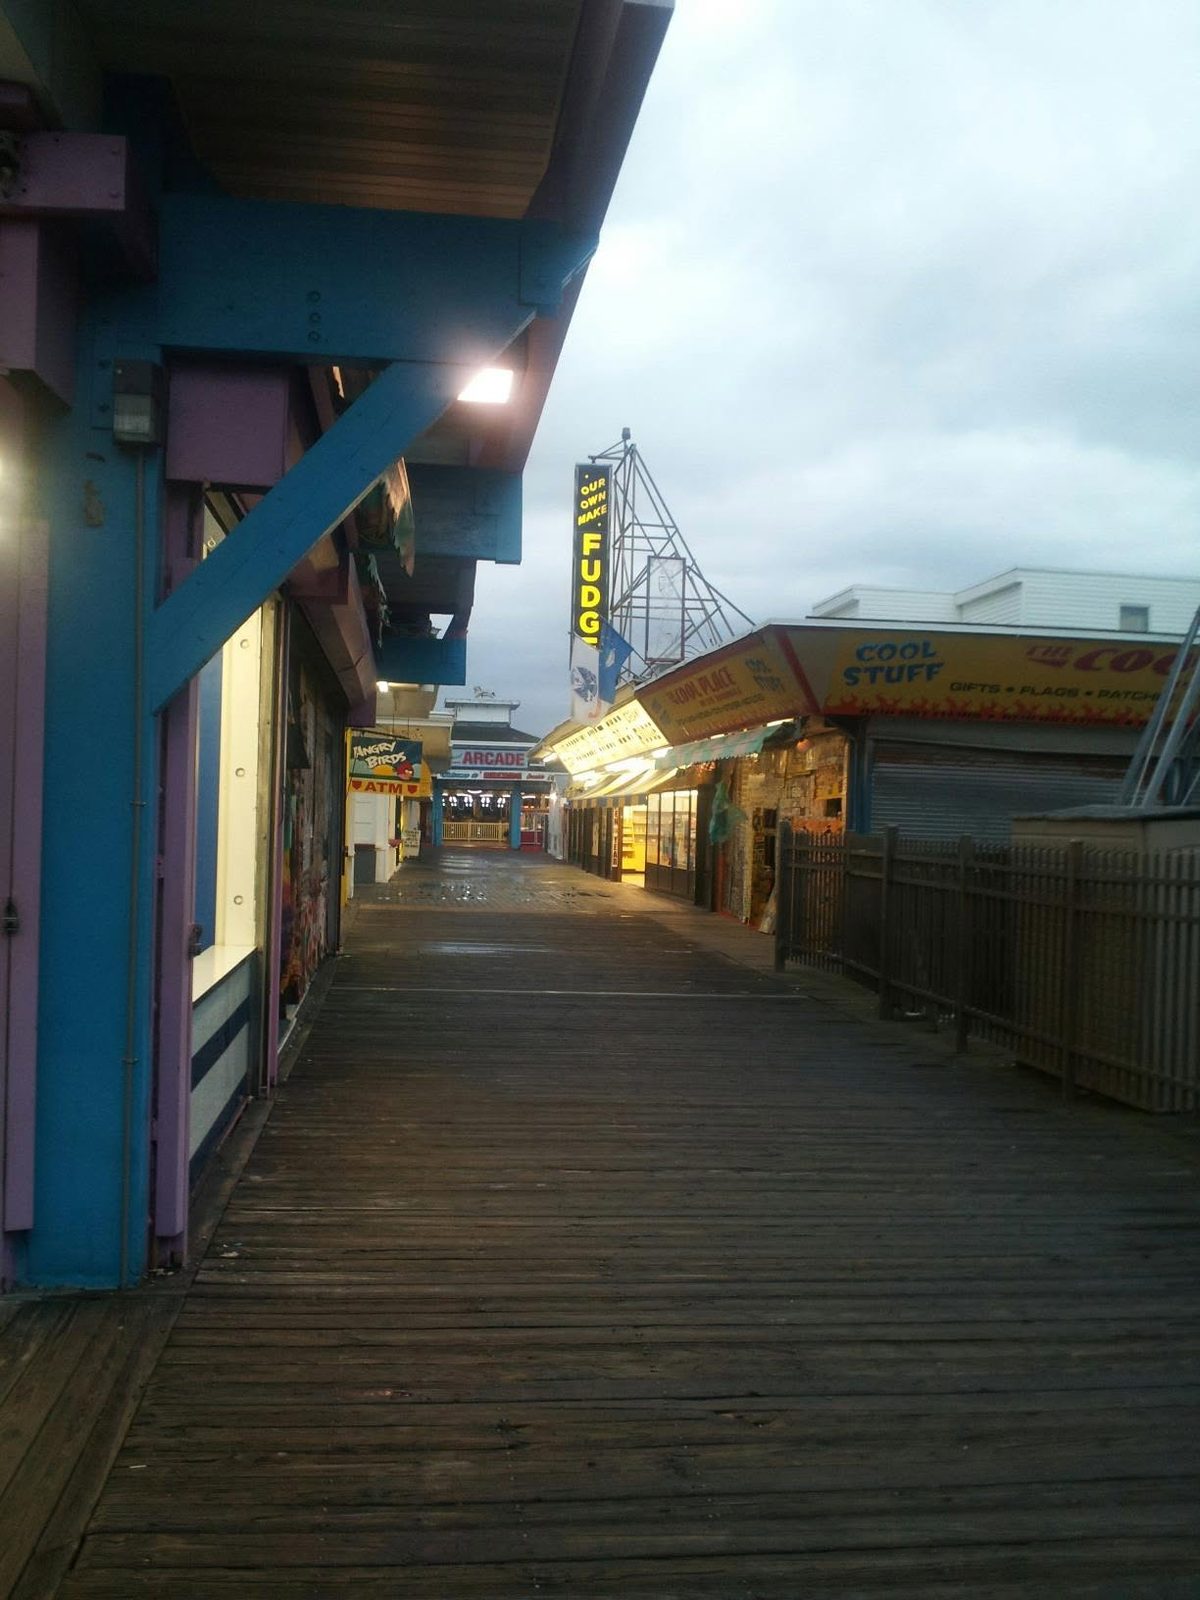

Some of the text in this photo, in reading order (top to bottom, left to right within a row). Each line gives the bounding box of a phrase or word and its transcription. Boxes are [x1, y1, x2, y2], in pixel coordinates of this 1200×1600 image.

[581, 478, 606, 496] OUR
[580, 491, 606, 510] OWN
[577, 504, 607, 526] MAKE
[855, 640, 936, 662] COOL
[843, 662, 943, 686] STUFF
[949, 682, 1161, 701] GIFTS FLAGS PATCH
[353, 741, 397, 758] ANGRY
[463, 751, 525, 766] ARCADE
[365, 751, 407, 769] BIRDS
[365, 781, 403, 794] ATM
